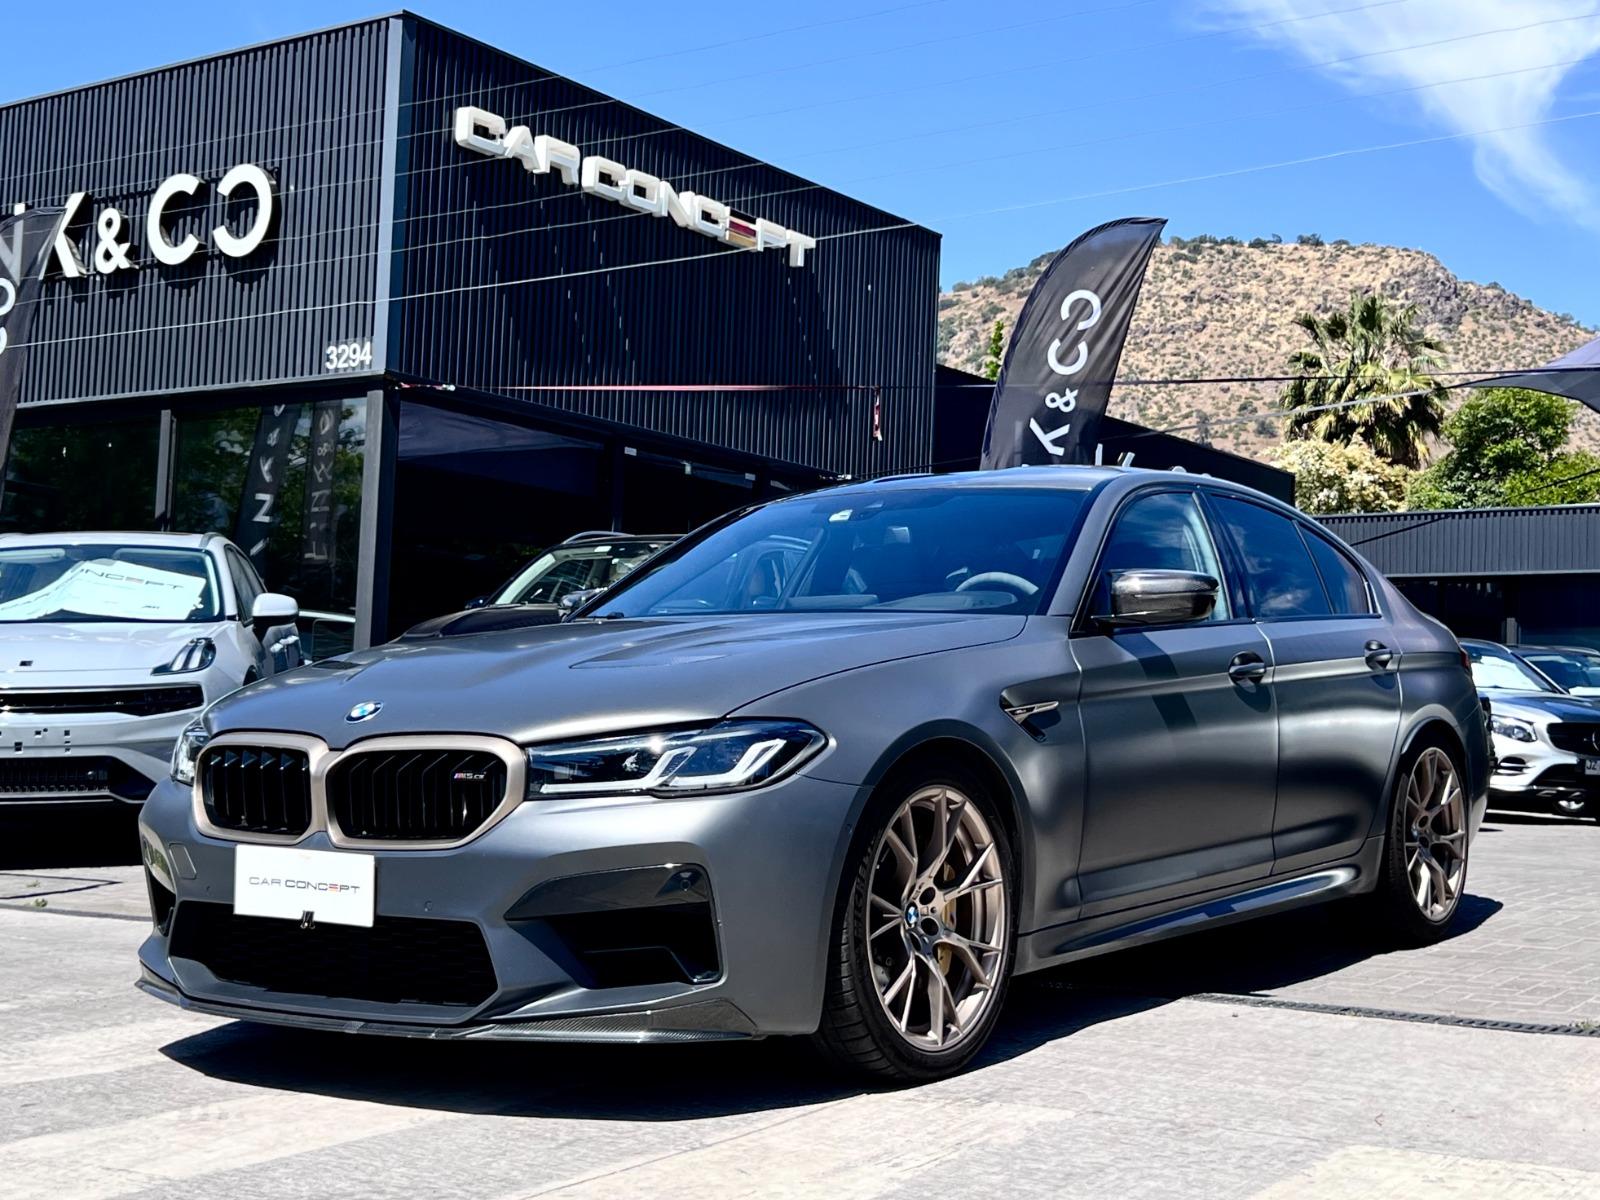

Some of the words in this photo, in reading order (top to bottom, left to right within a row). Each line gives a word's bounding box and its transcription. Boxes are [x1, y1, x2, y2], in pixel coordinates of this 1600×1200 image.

[455, 106, 580, 185] CAR
[581, 156, 816, 267] CONCEPT
[325, 341, 372, 370] 3294
[248, 876, 281, 887] CAR
[285, 879, 360, 893] CONCEPT
